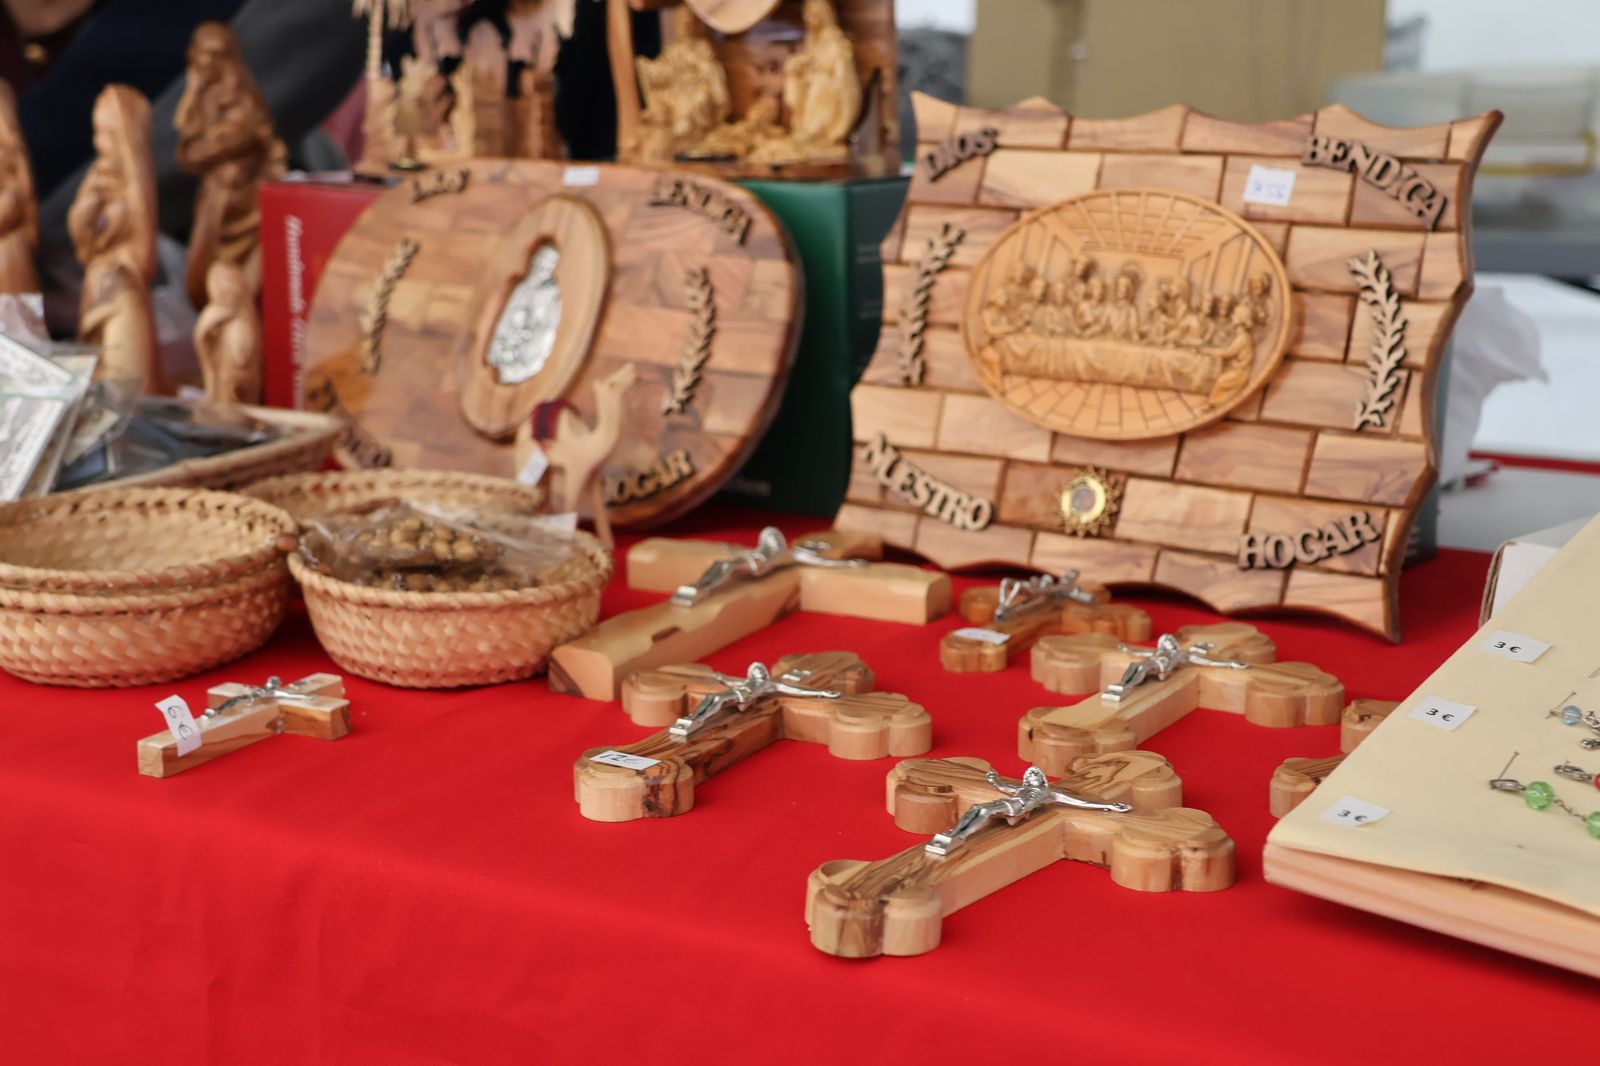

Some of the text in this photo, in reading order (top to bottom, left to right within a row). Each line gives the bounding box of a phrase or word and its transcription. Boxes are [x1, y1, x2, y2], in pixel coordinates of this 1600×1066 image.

[923, 126, 999, 182] DIOS
[1302, 134, 1449, 233] BENDIGA
[861, 431, 994, 532] NUESTRO
[1238, 510, 1382, 571] HOGAR
[1493, 641, 1522, 654] 3 €
[1425, 707, 1455, 722] 3 €
[1337, 809, 1351, 818] 3
